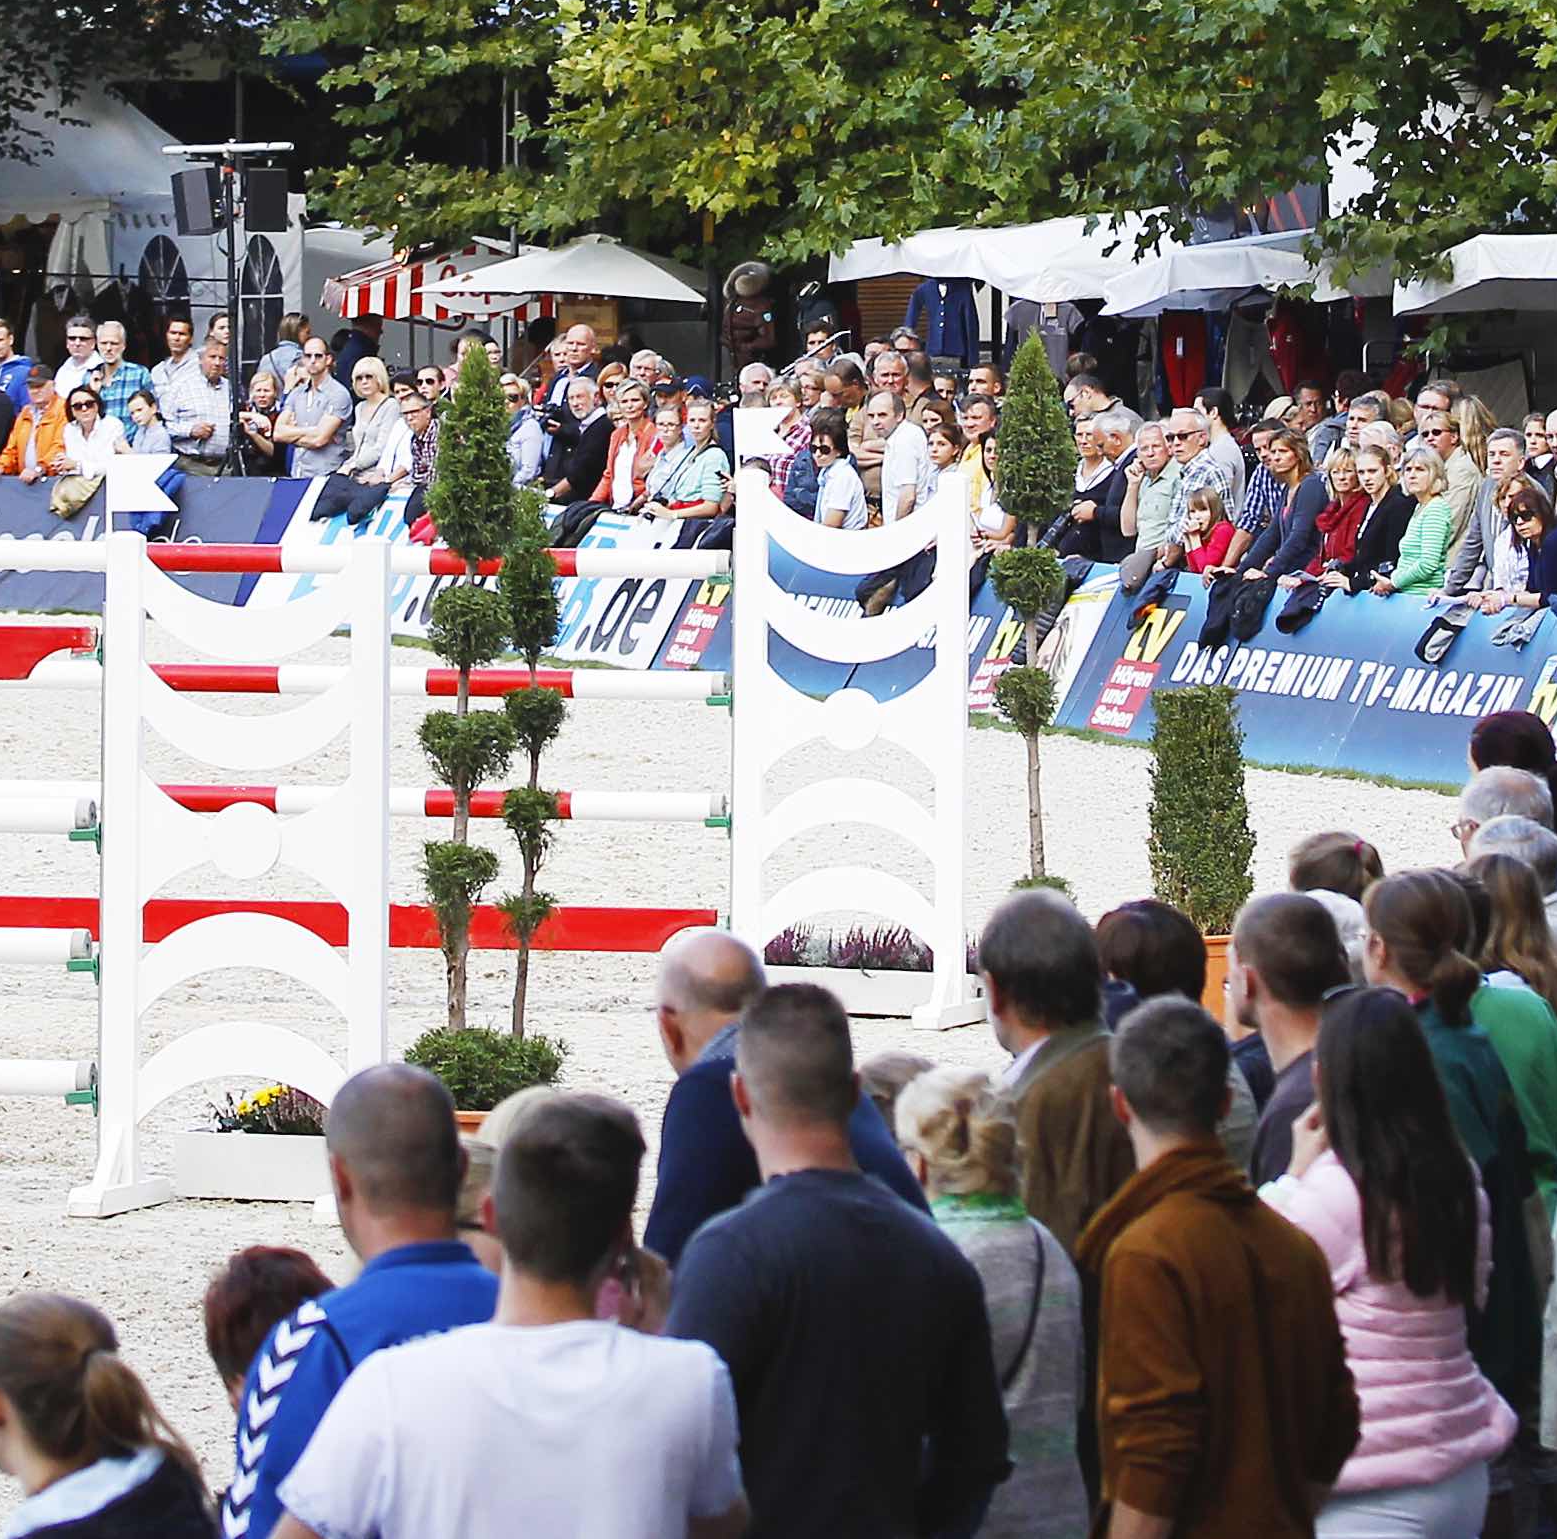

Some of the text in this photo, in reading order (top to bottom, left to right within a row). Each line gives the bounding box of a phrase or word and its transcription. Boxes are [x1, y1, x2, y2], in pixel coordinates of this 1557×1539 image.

[1110, 664, 1154, 688] Hören
[1170, 640, 1524, 718] DAS PREMIUM TV-MAGAZIN
[1100, 686, 1131, 707] und
[1091, 705, 1135, 730] Sehen
